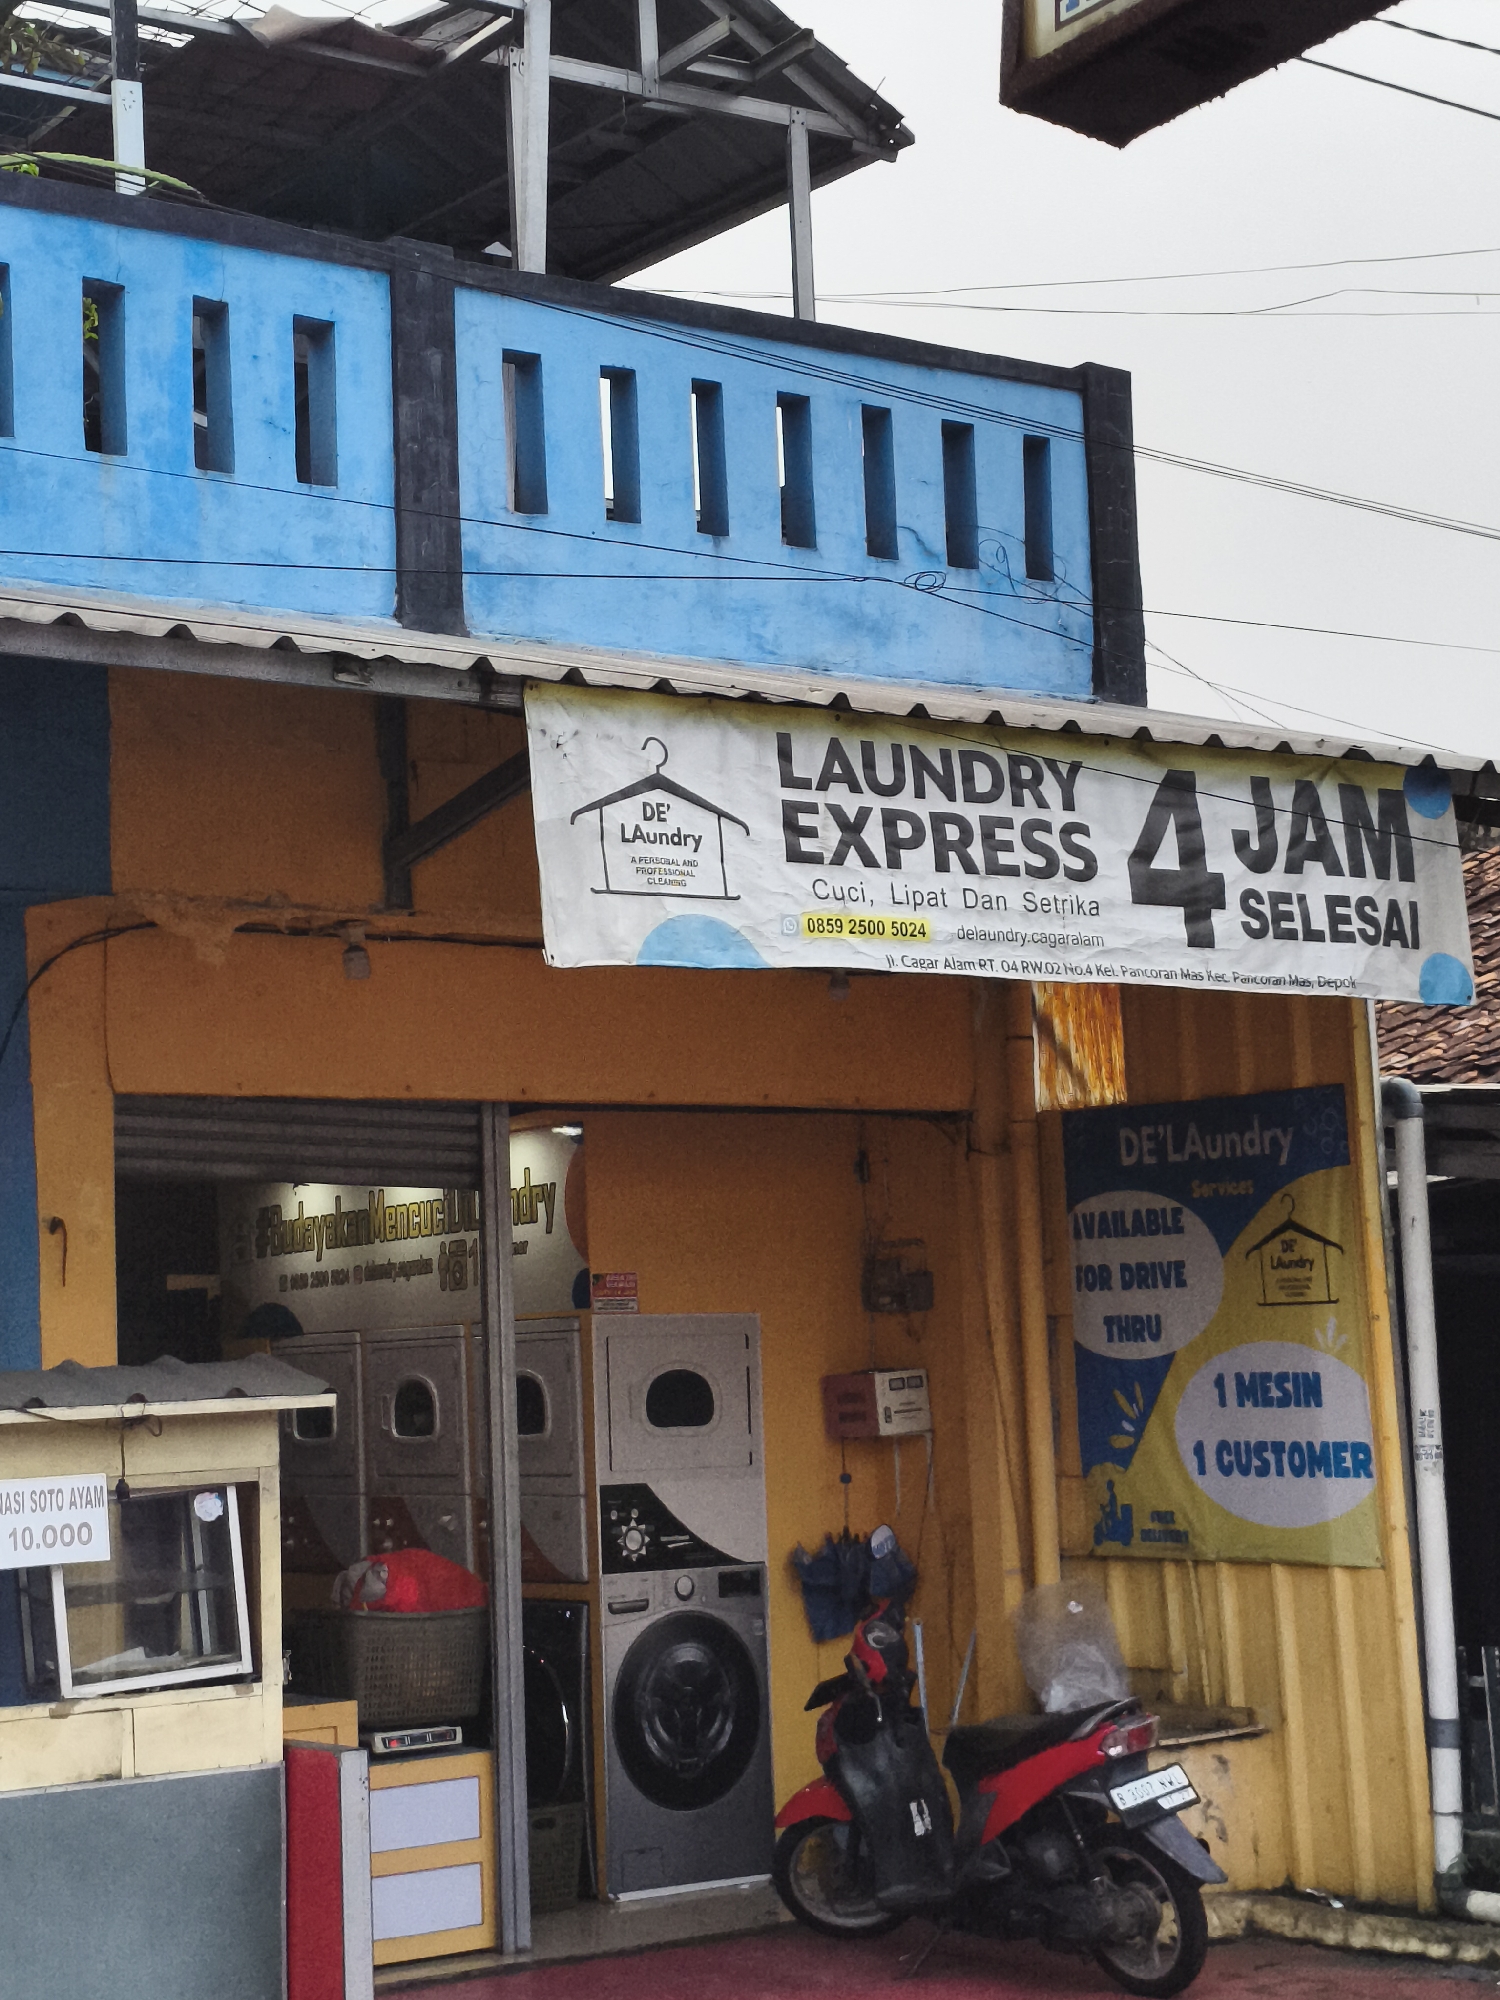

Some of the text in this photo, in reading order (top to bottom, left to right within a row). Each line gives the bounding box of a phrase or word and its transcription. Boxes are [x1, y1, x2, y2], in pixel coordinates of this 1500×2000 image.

[776, 732, 1083, 812] LAUNDRY
[642, 801, 671, 822] DE'
[621, 823, 702, 853] LAundry
[781, 798, 1098, 882] EXPRESS
[631, 856, 699, 868] A PERSONAL AND
[636, 866, 695, 878] PROFESSIONAL
[1128, 769, 1415, 948] 4 JAM
[647, 877, 687, 887] CLEANING
[812, 878, 1100, 917] Cuci, Lipat Dan Setrika
[807, 917, 927, 938] 0859 2500 5024
[1240, 887, 1420, 950] SELESAI
[957, 925, 1105, 948] delaundry.cagaralam
[901, 955, 938, 971] Cagar
[944, 956, 976, 971] Alam
[1001, 960, 1018, 973] 04
[1121, 965, 1177, 980] Pancoran
[1180, 967, 1204, 981] Mas
[1232, 971, 1286, 986] Pancoran
[1318, 975, 1357, 991] Depok
[1120, 1260, 1188, 1291] DRIVE
[1103, 1314, 1162, 1343] THRU
[1214, 1371, 1323, 1408] 1 MESIN
[1193, 1439, 1206, 1476] 1
[1215, 1439, 1374, 1479] CUSTOMER
[30, 1488, 64, 1513] SOTO
[69, 1485, 105, 1510] AYAM
[9, 1521, 93, 1551] 10.000
